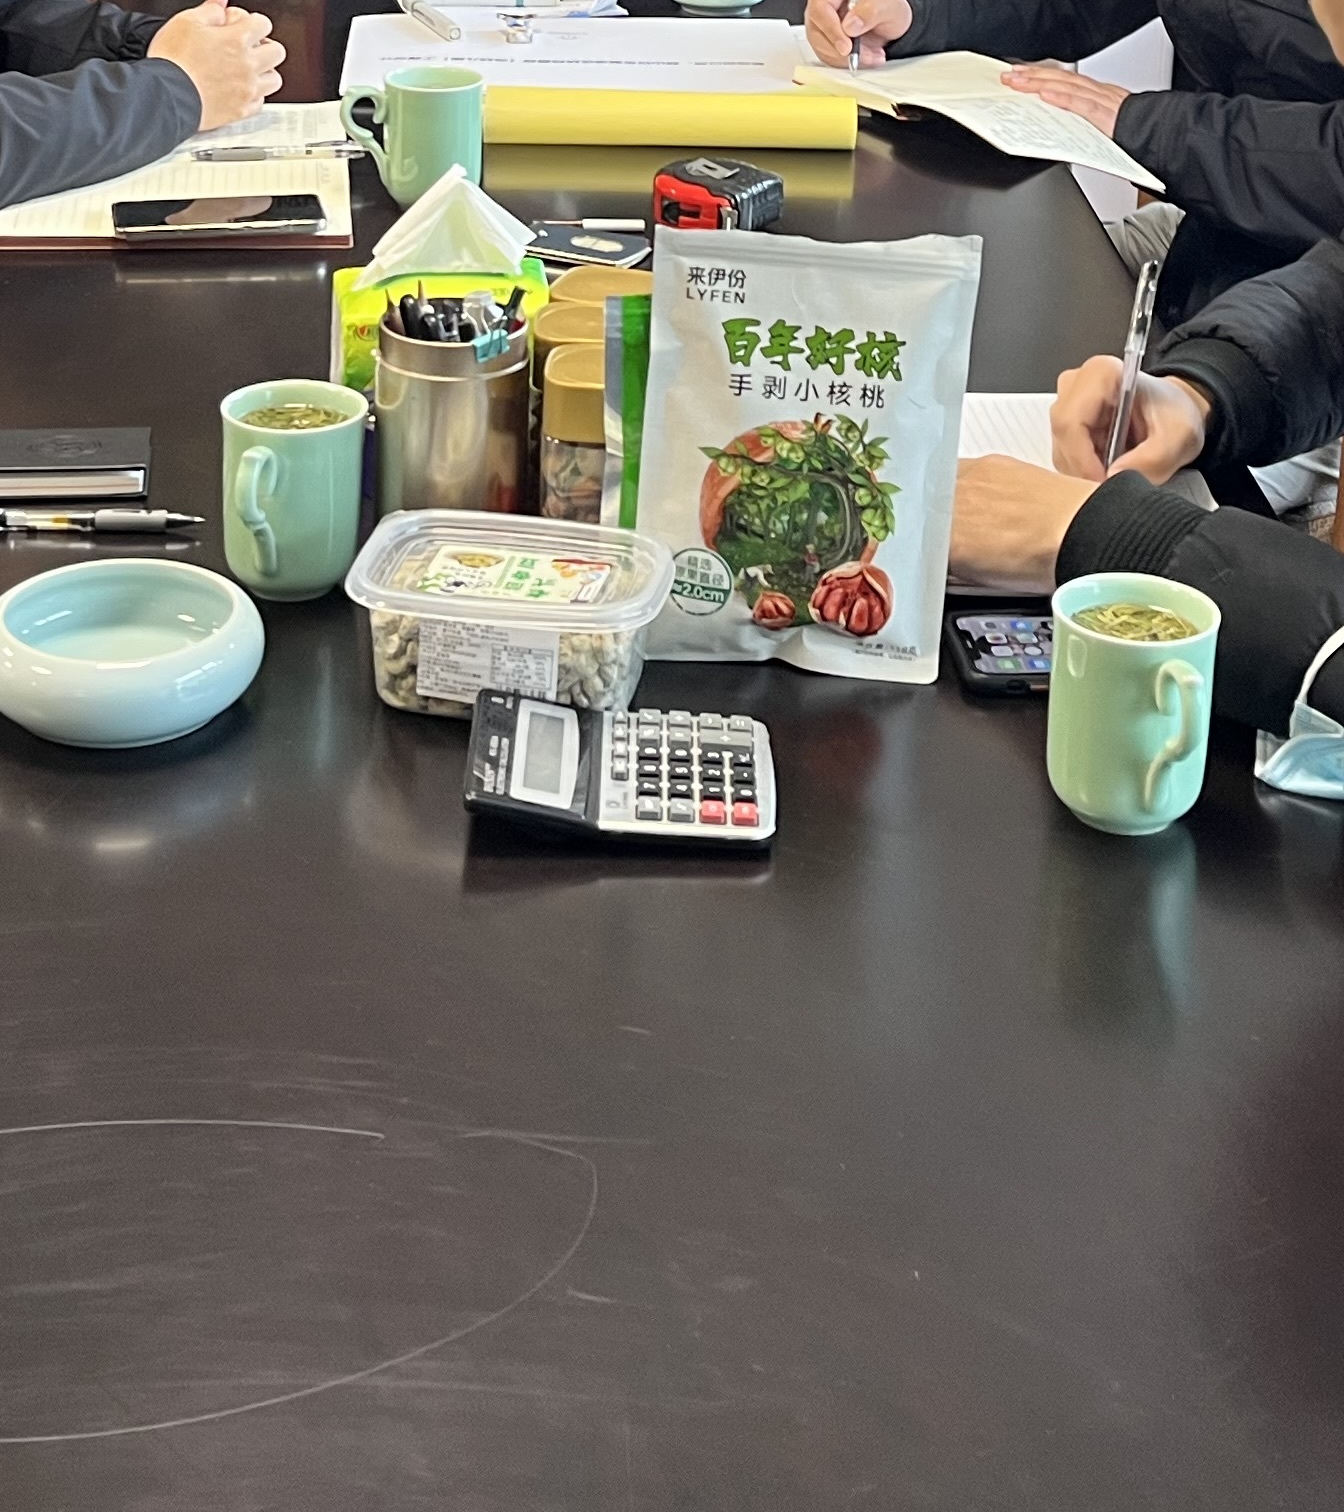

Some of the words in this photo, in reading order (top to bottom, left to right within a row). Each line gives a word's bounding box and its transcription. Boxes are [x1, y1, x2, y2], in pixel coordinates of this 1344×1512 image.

[686, 266, 747, 290] 来伊份
[685, 287, 747, 305] LYFEN
[721, 318, 907, 382] 百年好核
[728, 373, 886, 410] 手剥小核桃
